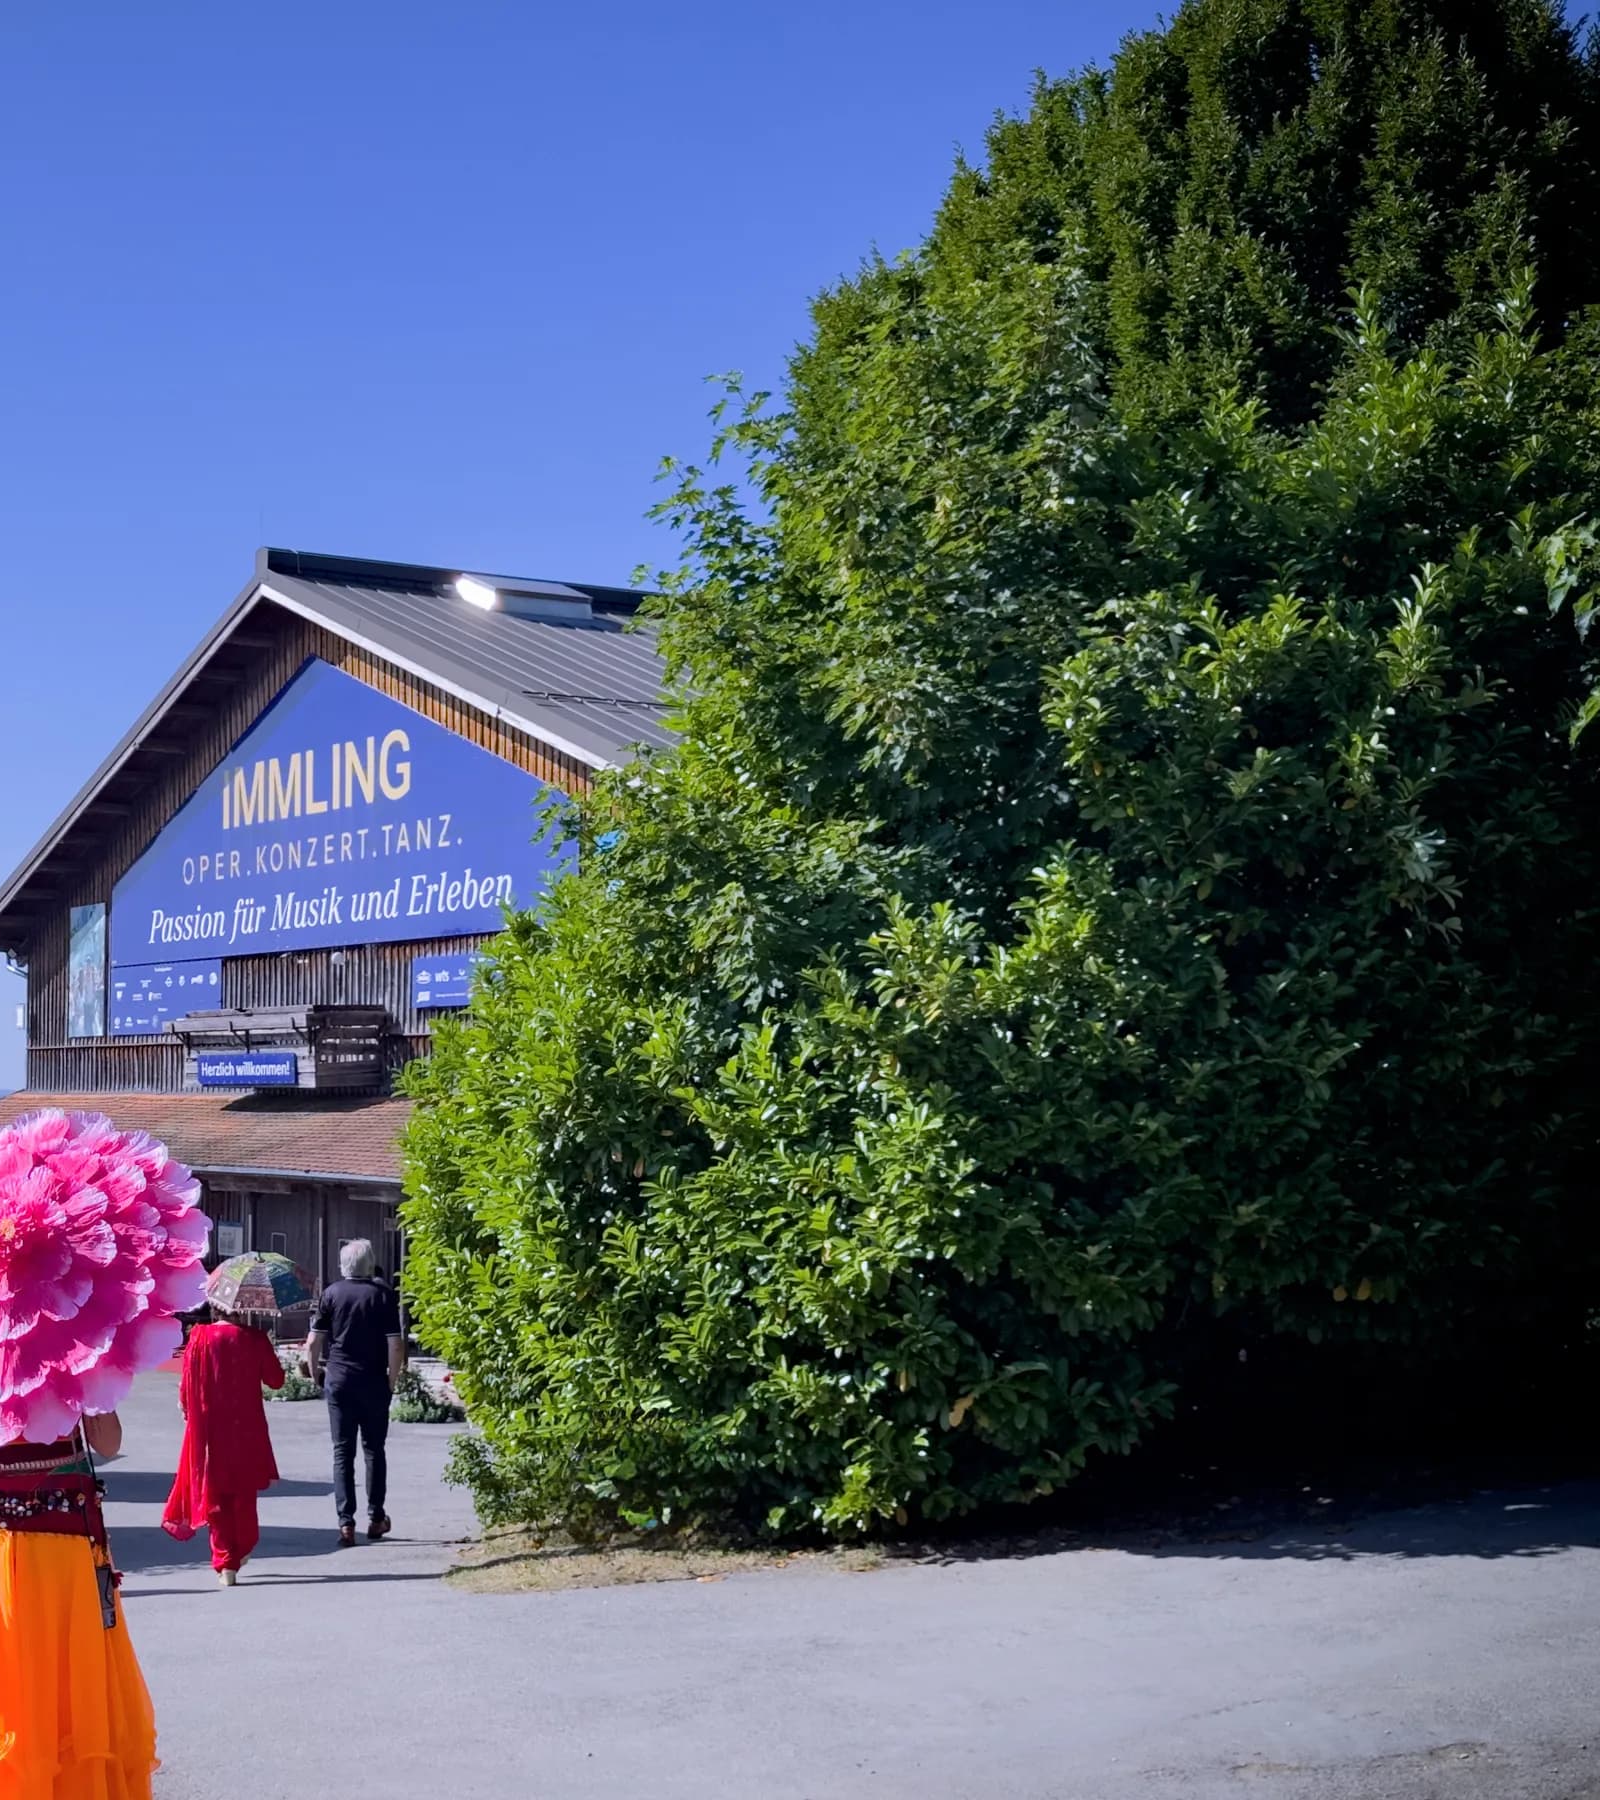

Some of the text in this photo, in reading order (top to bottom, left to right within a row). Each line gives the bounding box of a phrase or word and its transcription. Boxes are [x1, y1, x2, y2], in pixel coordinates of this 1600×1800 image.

[223, 729, 410, 829] IMMLING
[148, 868, 513, 943] Passion für Musik und Erleben
[201, 1060, 290, 1076] Herzlich willkommen!
